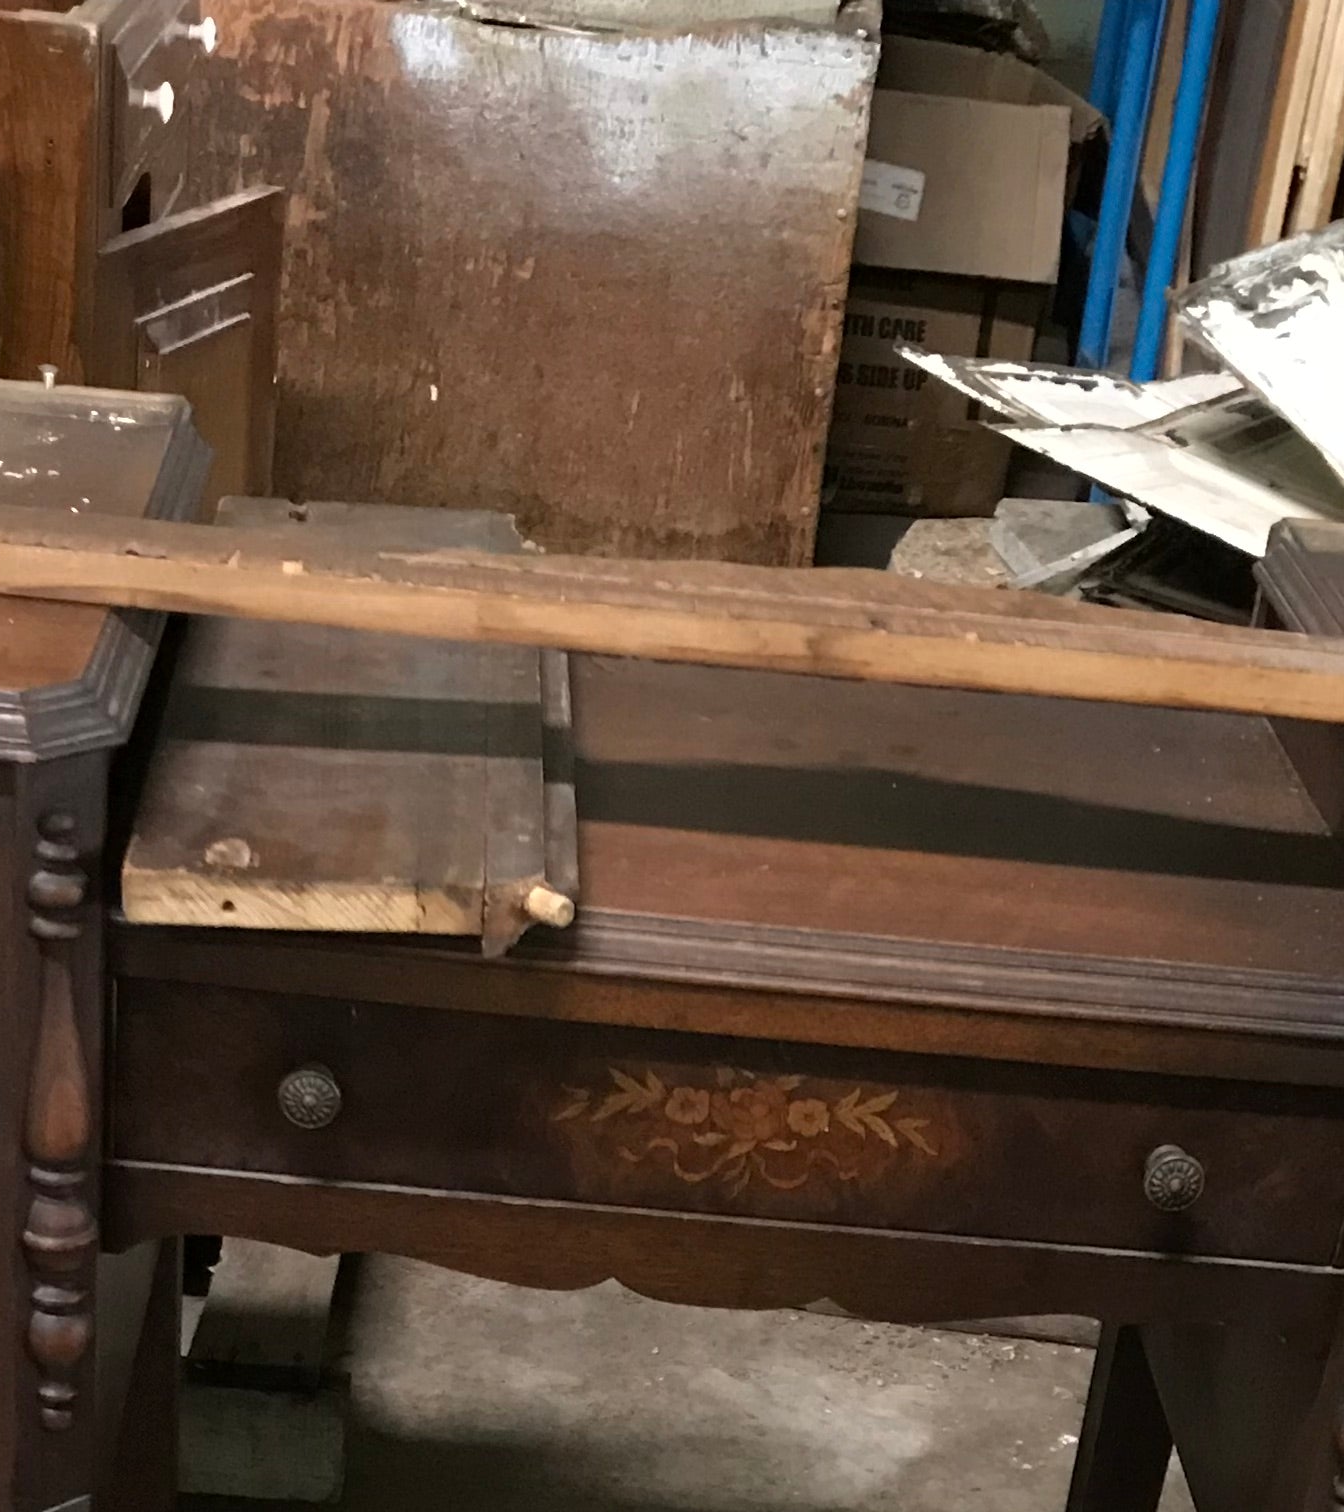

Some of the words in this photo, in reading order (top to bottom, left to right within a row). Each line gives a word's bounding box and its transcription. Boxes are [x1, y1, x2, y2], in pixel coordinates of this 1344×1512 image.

[879, 316, 927, 342] CARE
[856, 363, 900, 389] SIDE
[903, 367, 929, 391] UP
